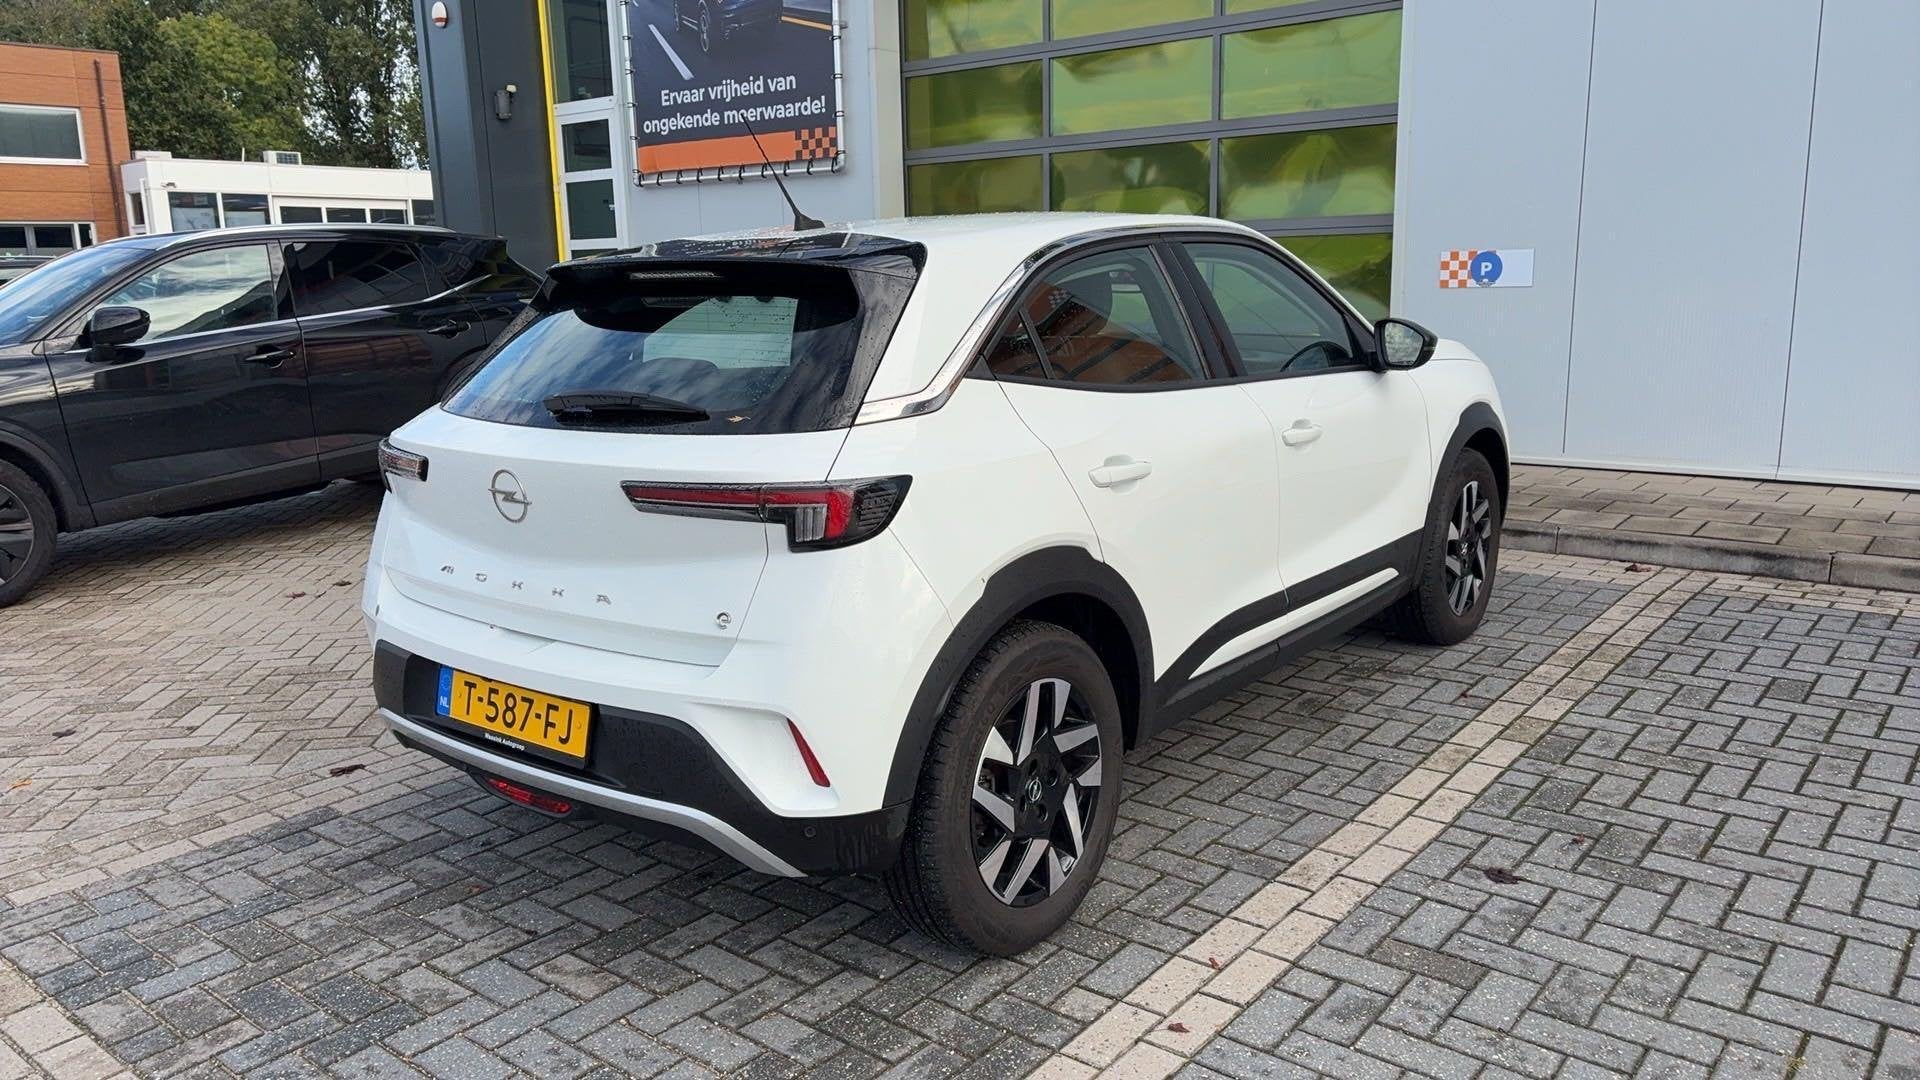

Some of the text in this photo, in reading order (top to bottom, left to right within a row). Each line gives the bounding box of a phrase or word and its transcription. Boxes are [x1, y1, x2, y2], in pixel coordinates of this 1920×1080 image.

[661, 74, 796, 106] Ervaar vrijheid van
[643, 95, 826, 136] ongekende meerwaarde!
[1480, 262, 1493, 276] P
[439, 695, 450, 709] NL
[463, 680, 574, 745] T-587-FJ
